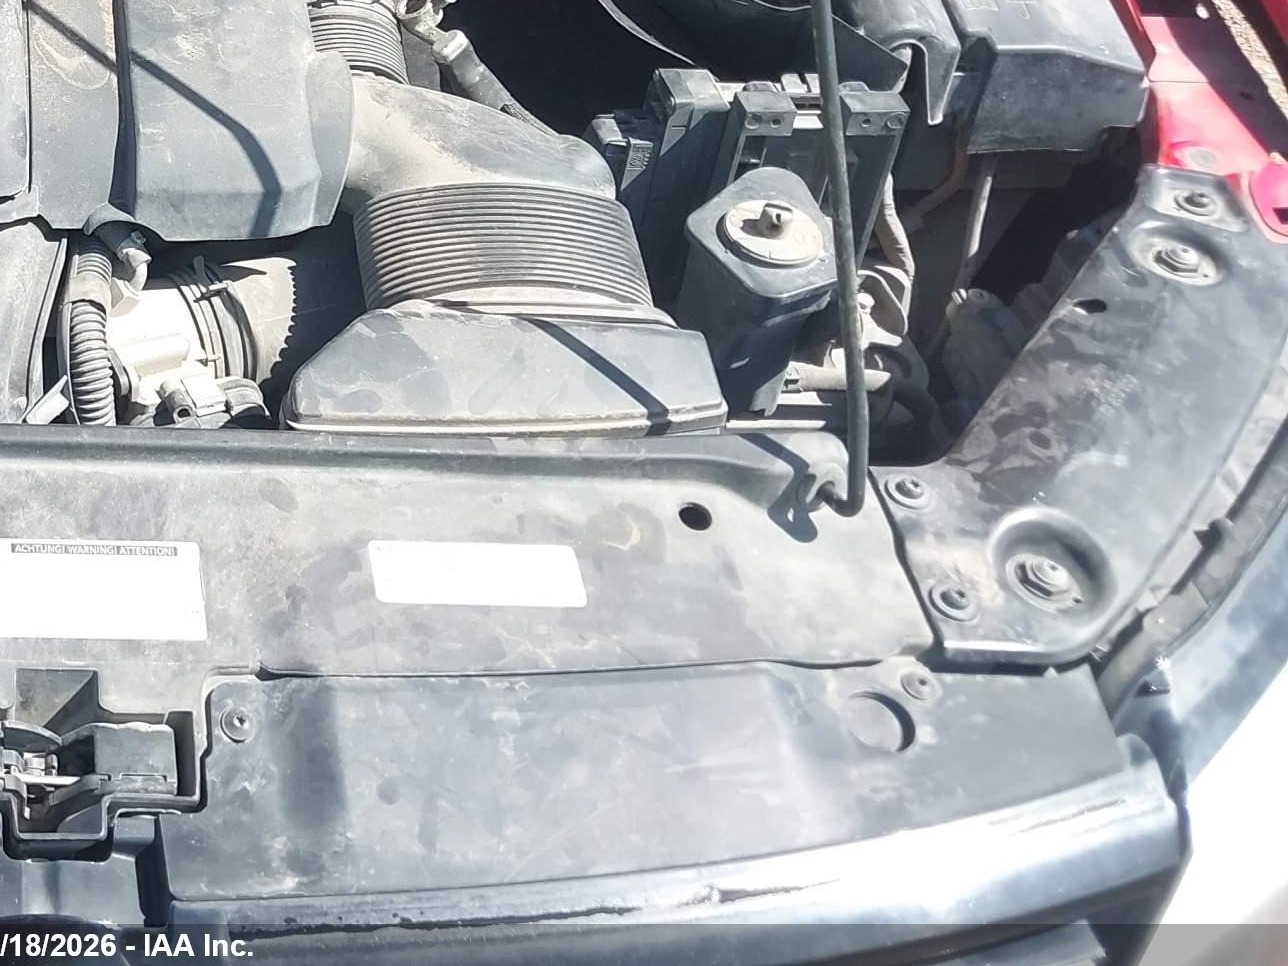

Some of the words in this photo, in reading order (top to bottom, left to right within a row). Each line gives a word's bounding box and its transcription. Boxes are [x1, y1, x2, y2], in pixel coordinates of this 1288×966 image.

[14, 543, 65, 554] ACHTUNG!
[67, 544, 117, 555] WARNING!
[119, 545, 175, 556] ATTENTION!
